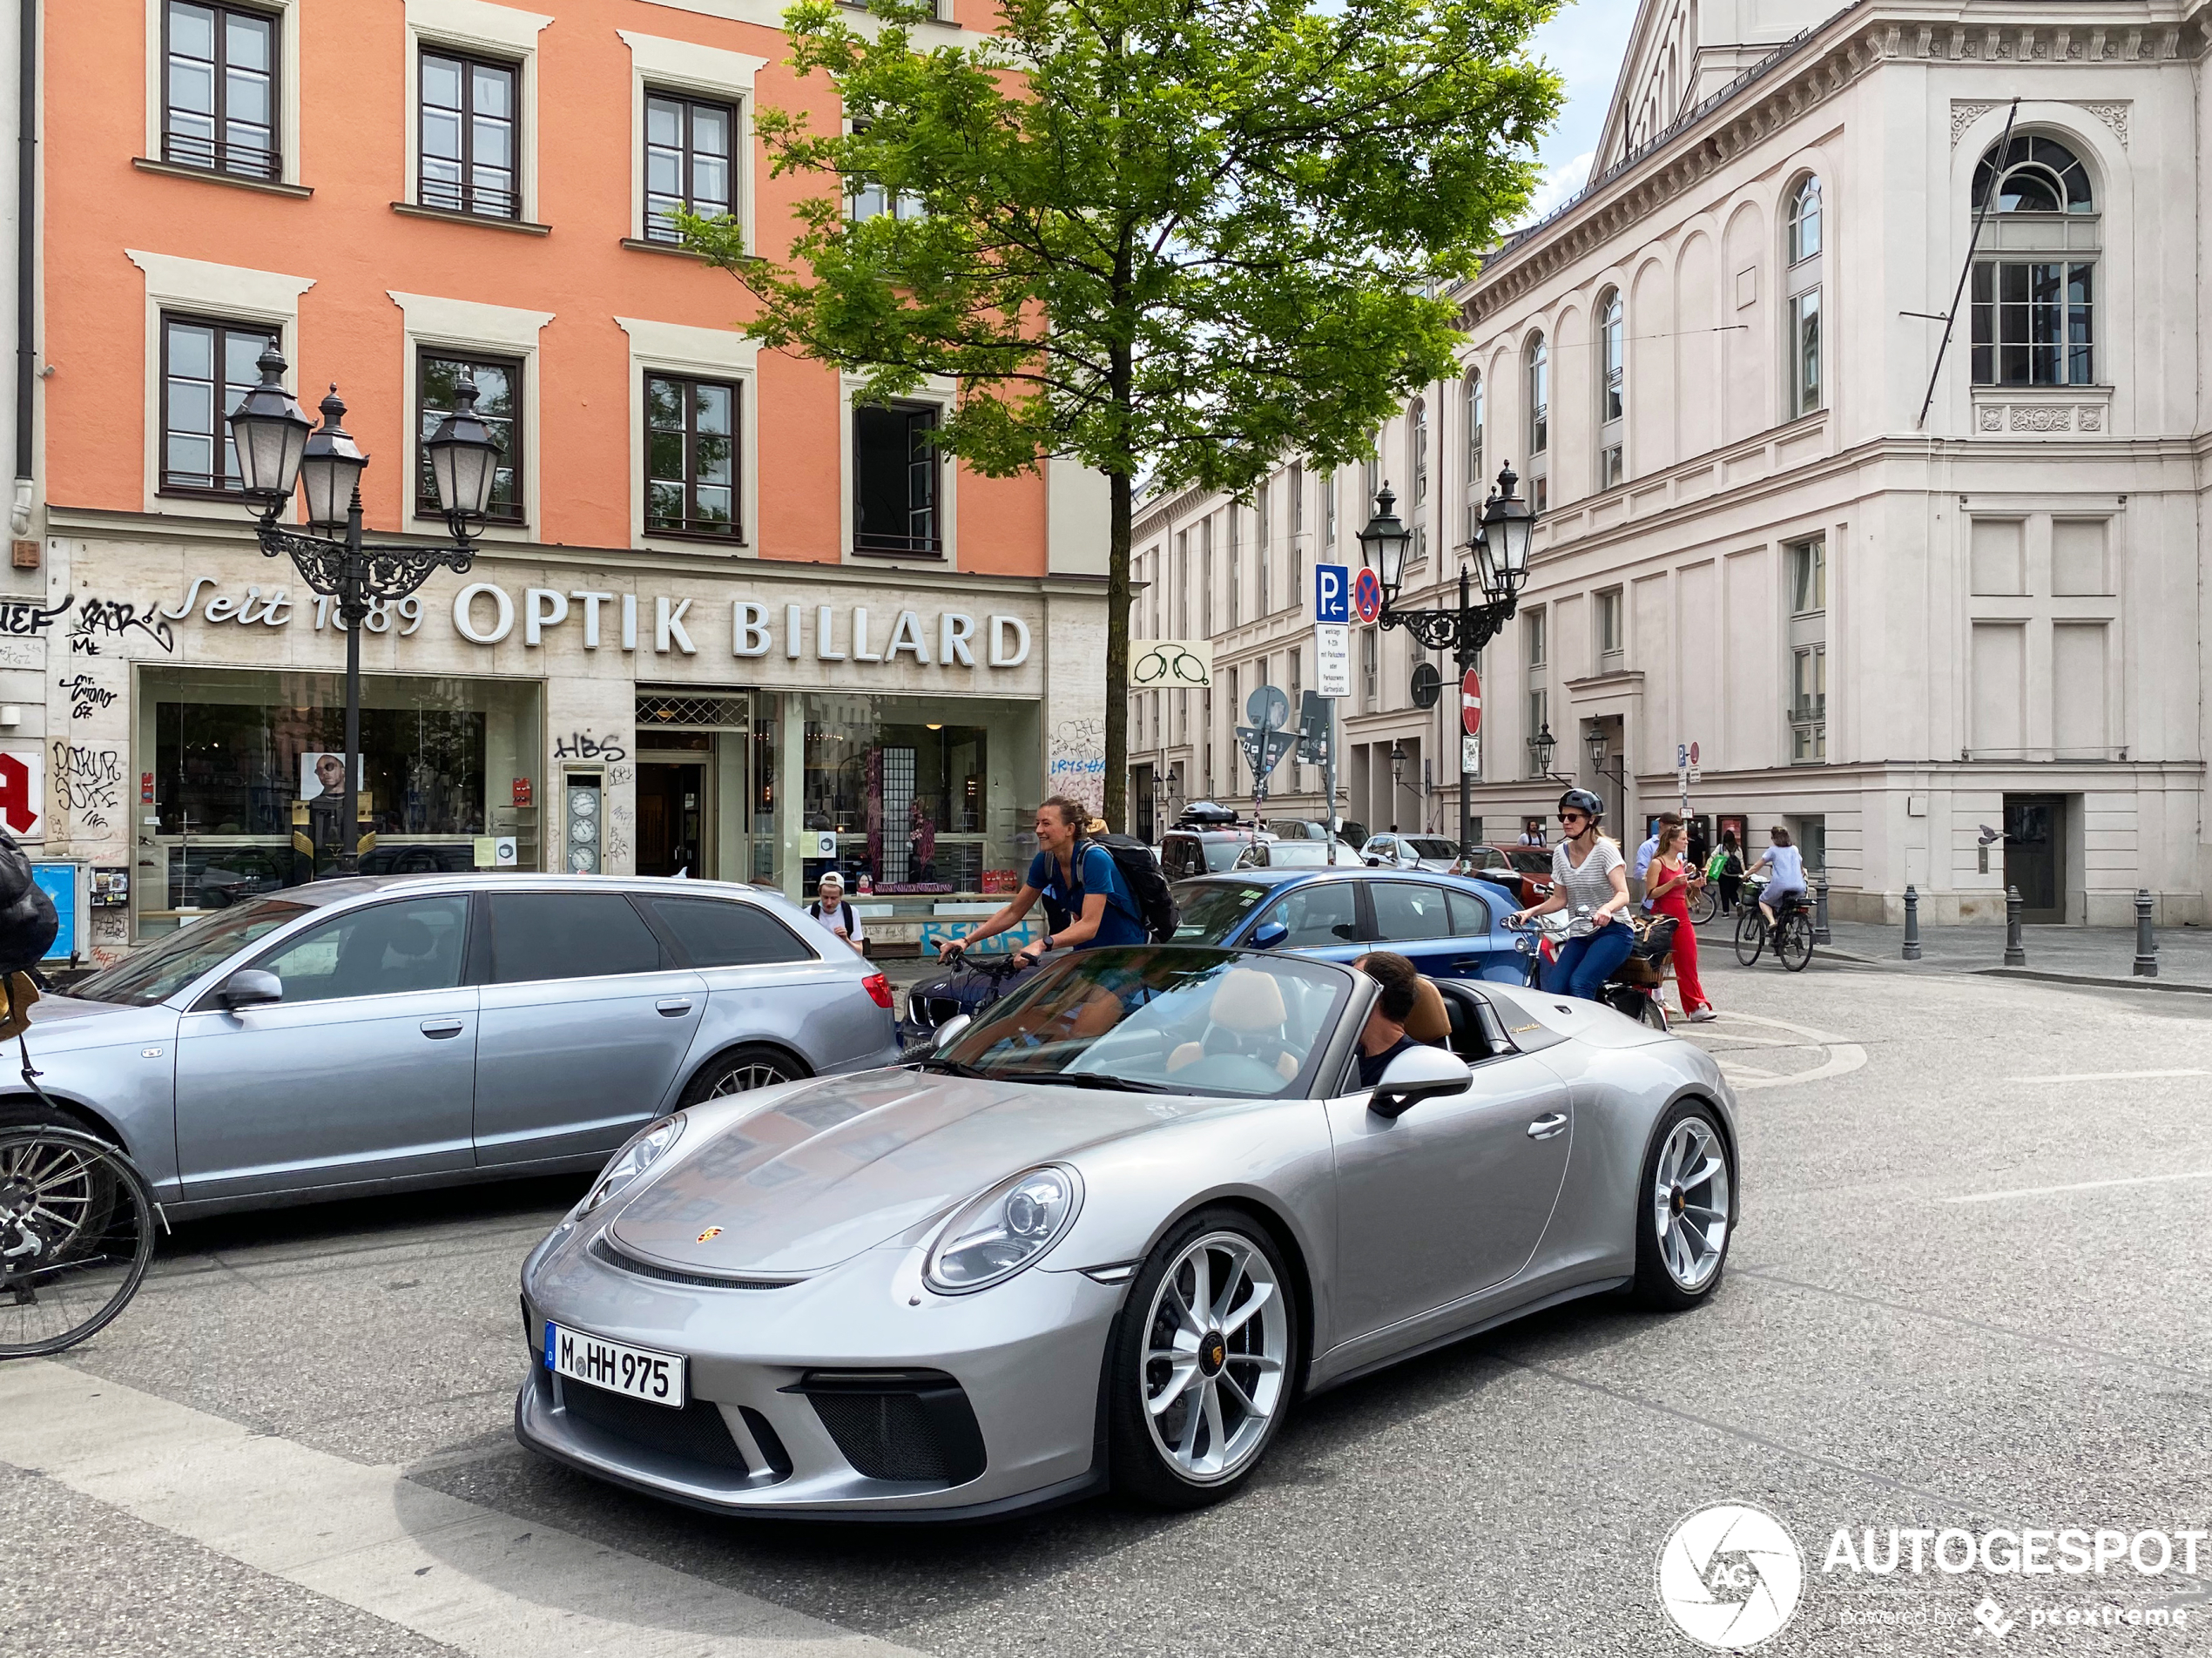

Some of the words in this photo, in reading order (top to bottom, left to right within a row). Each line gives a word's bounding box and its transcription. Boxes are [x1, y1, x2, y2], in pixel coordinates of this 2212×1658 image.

[1320, 571, 1339, 615] P
[161, 575, 293, 626] Seit
[453, 582, 697, 655] OPTIK
[732, 600, 1031, 668] BILLARD
[548, 1351, 553, 1361] D
[561, 1333, 574, 1372] M
[587, 1342, 617, 1386] HH
[622, 1352, 669, 1398] 975
